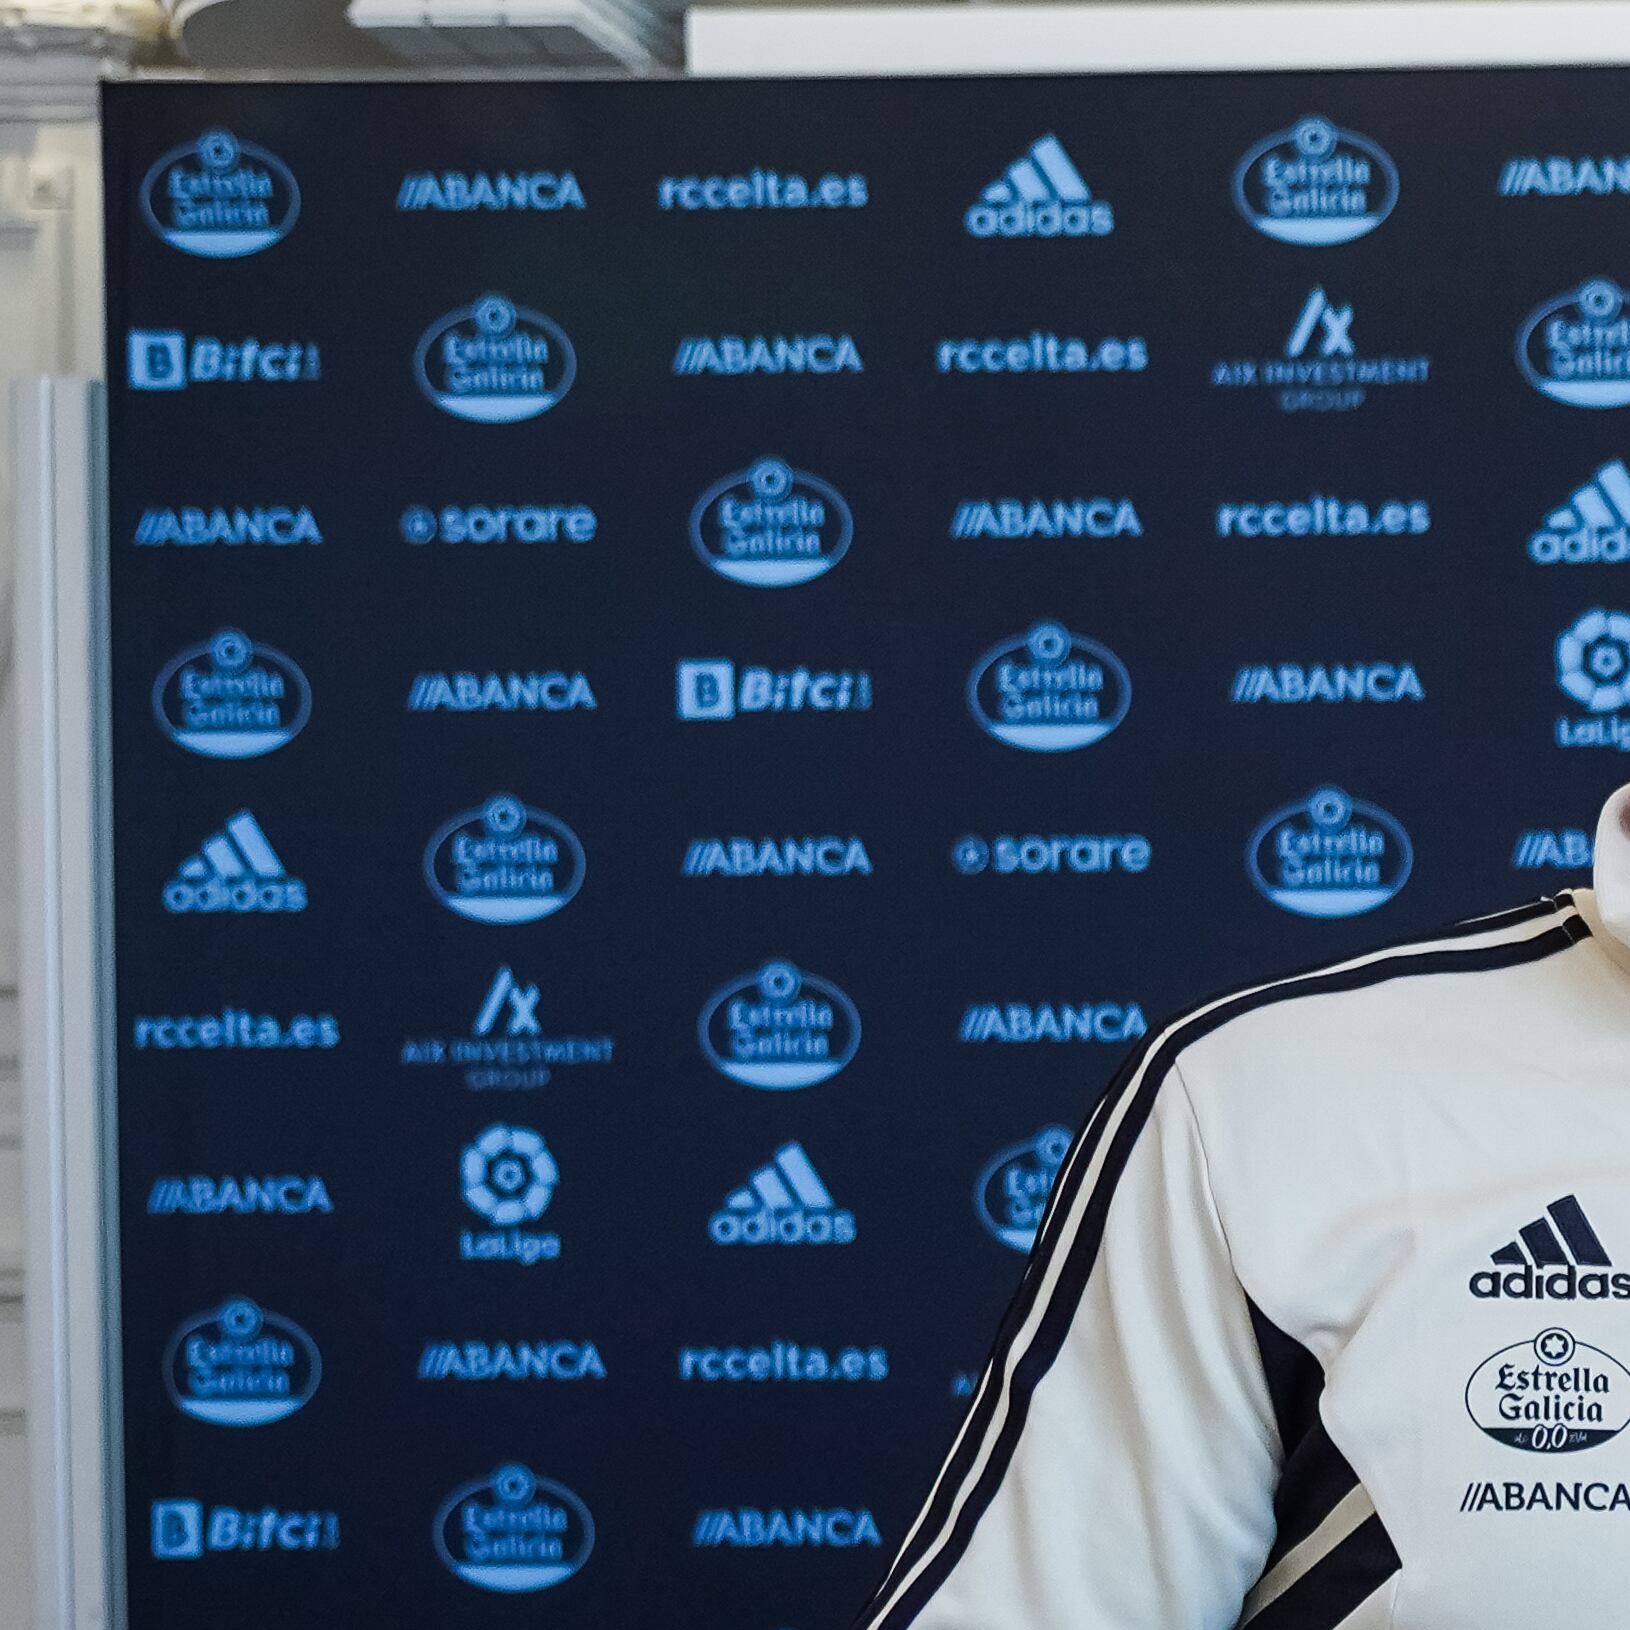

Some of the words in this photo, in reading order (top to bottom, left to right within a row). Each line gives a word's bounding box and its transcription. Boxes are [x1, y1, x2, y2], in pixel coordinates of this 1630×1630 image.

[966, 201, 1112, 236] adidas
[164, 876, 307, 912] adidas
[709, 1208, 856, 1244] adidas
[1495, 1363, 1610, 1393] Estrella
[1499, 1392, 1604, 1422] Galicia
